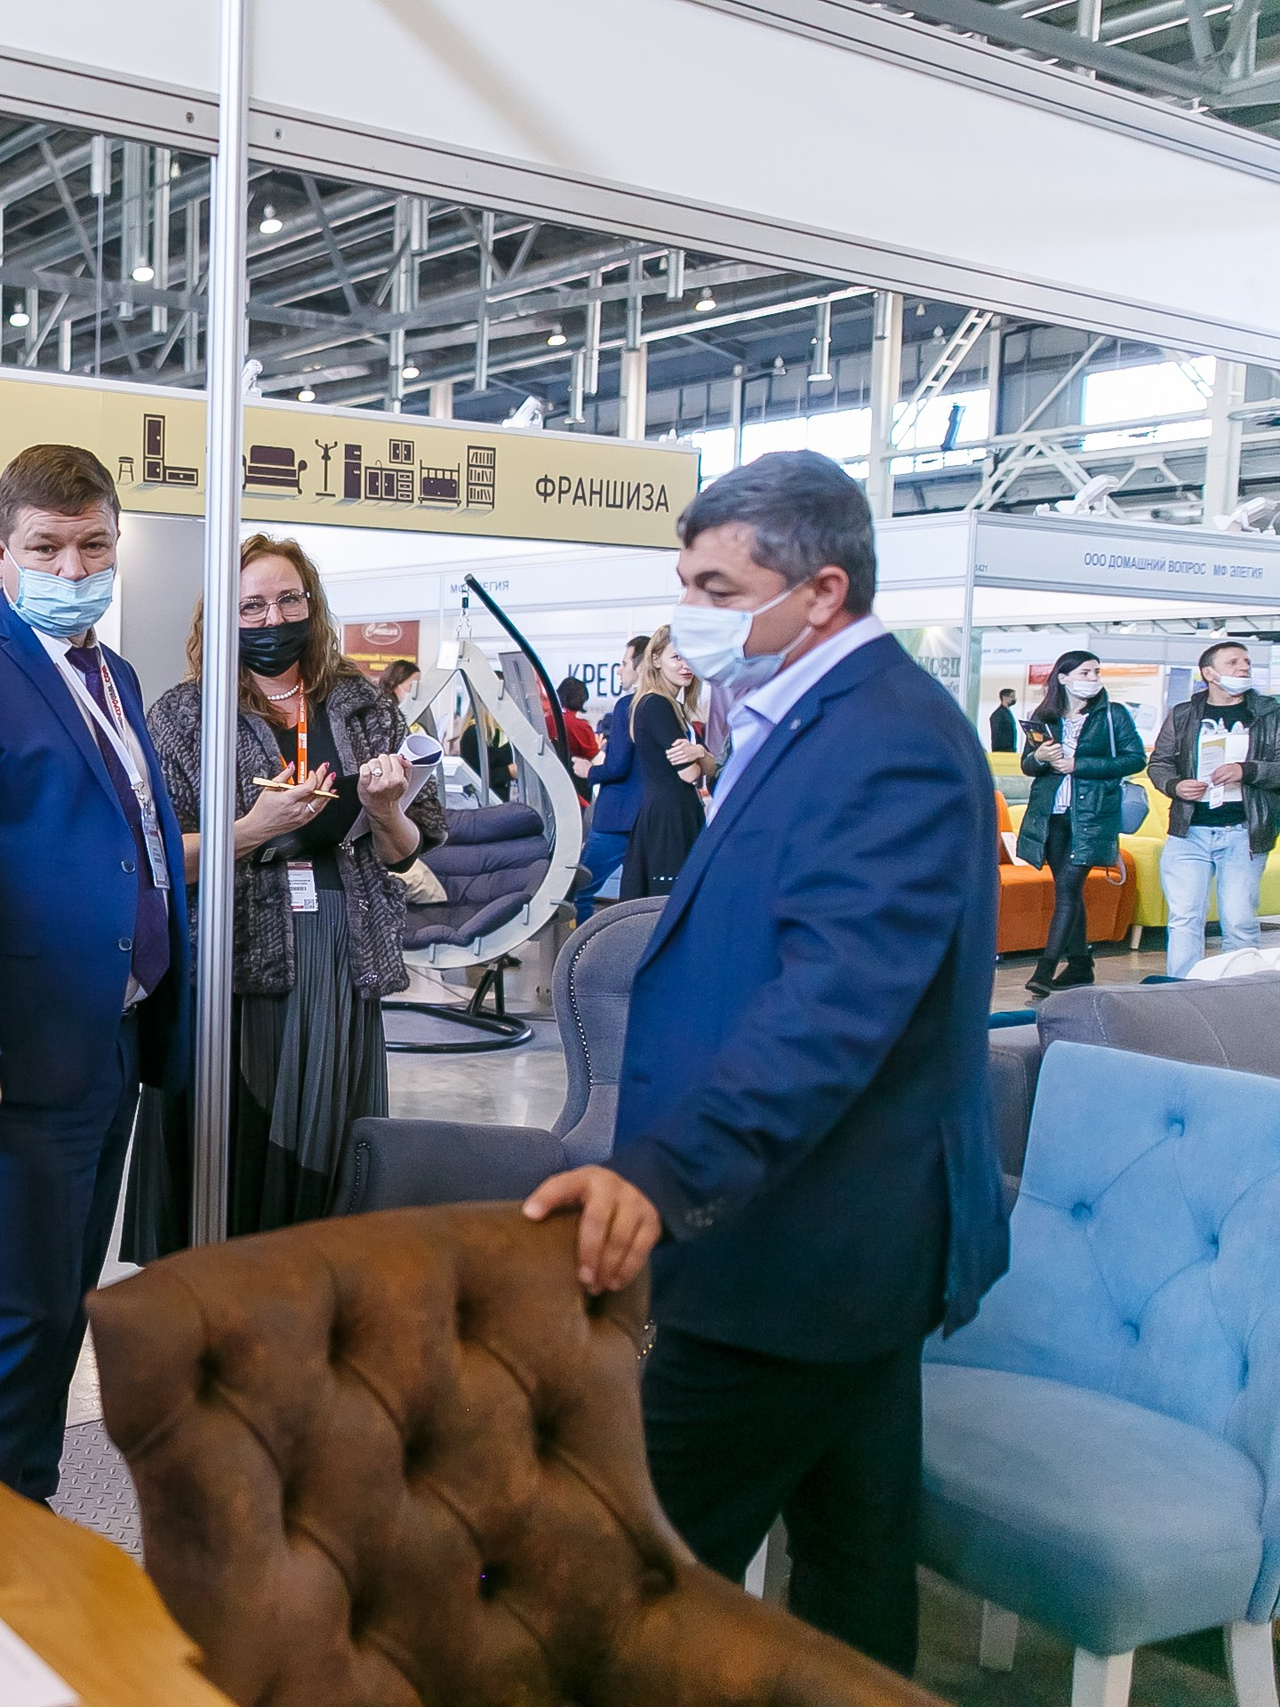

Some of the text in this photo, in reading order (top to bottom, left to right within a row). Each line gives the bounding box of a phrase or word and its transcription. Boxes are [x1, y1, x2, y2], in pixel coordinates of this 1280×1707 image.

[536, 474, 669, 513] ФРАНШИЗА
[1084, 552, 1106, 567] ООО
[1108, 555, 1166, 572] ДОМАШНИЙ
[1168, 560, 1207, 576] ВОПРОС
